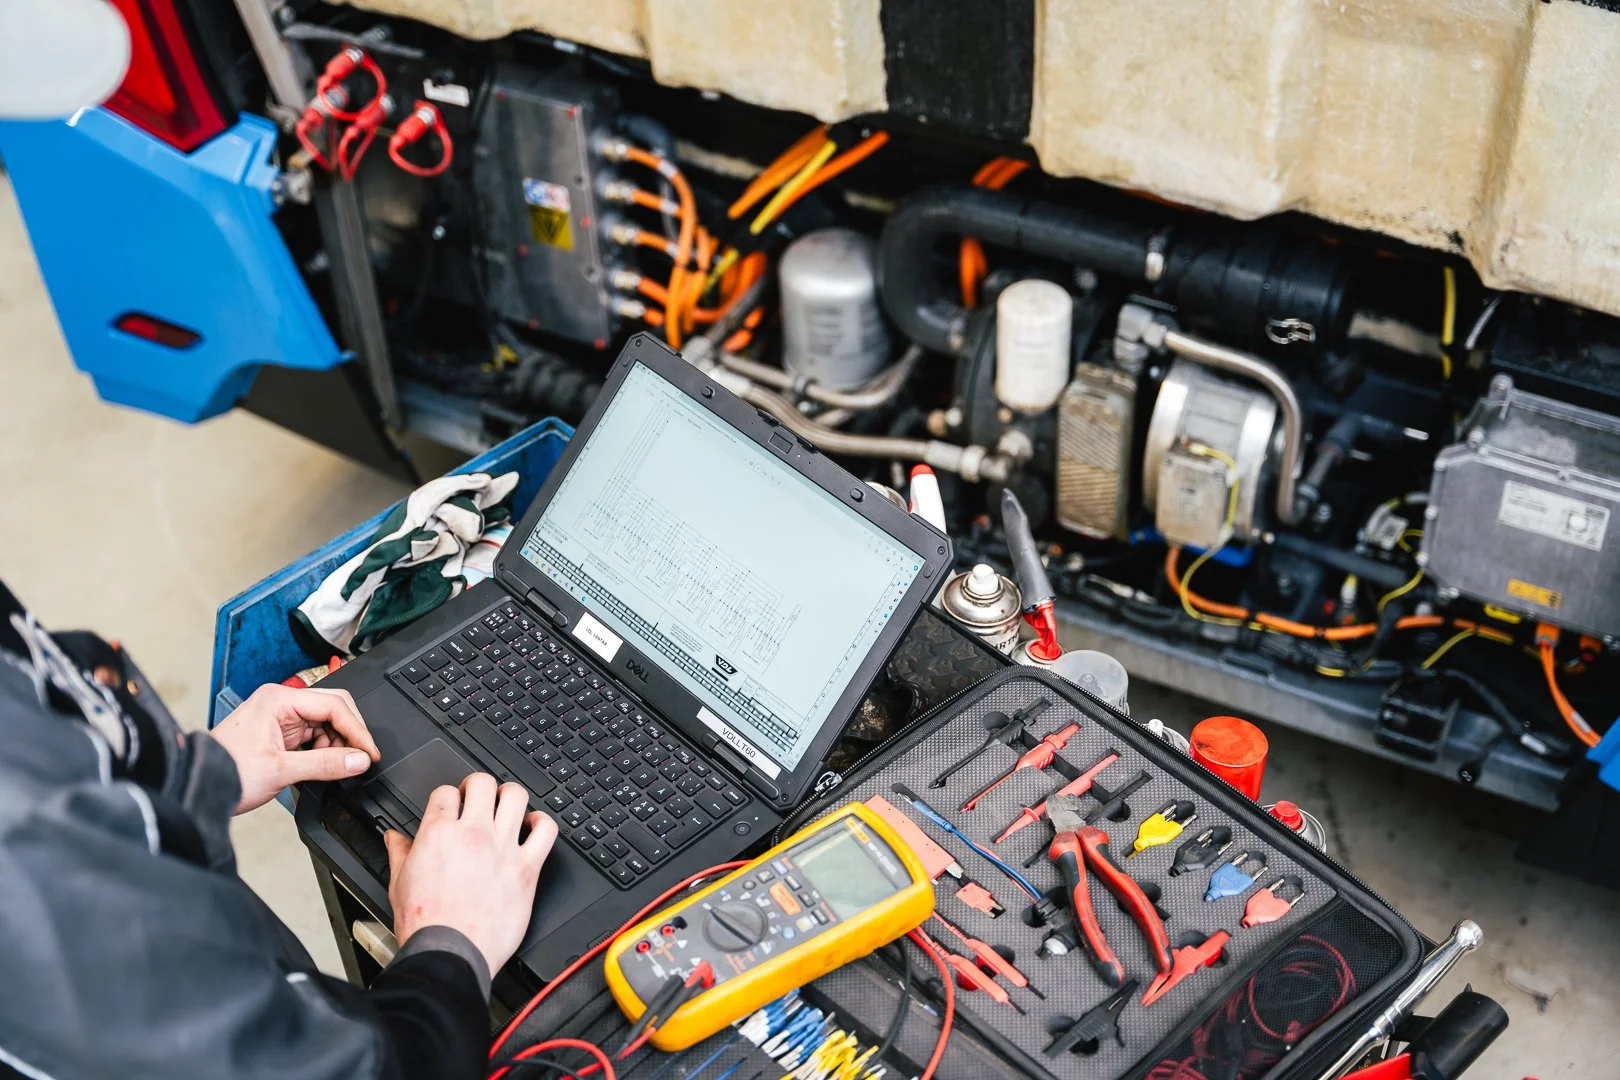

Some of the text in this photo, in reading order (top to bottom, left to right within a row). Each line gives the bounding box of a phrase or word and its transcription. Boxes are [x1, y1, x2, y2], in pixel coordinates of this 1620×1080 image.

[625, 658, 650, 683] DELL
[717, 656, 735, 673] VDL
[722, 727, 756, 758] VDLLT60
